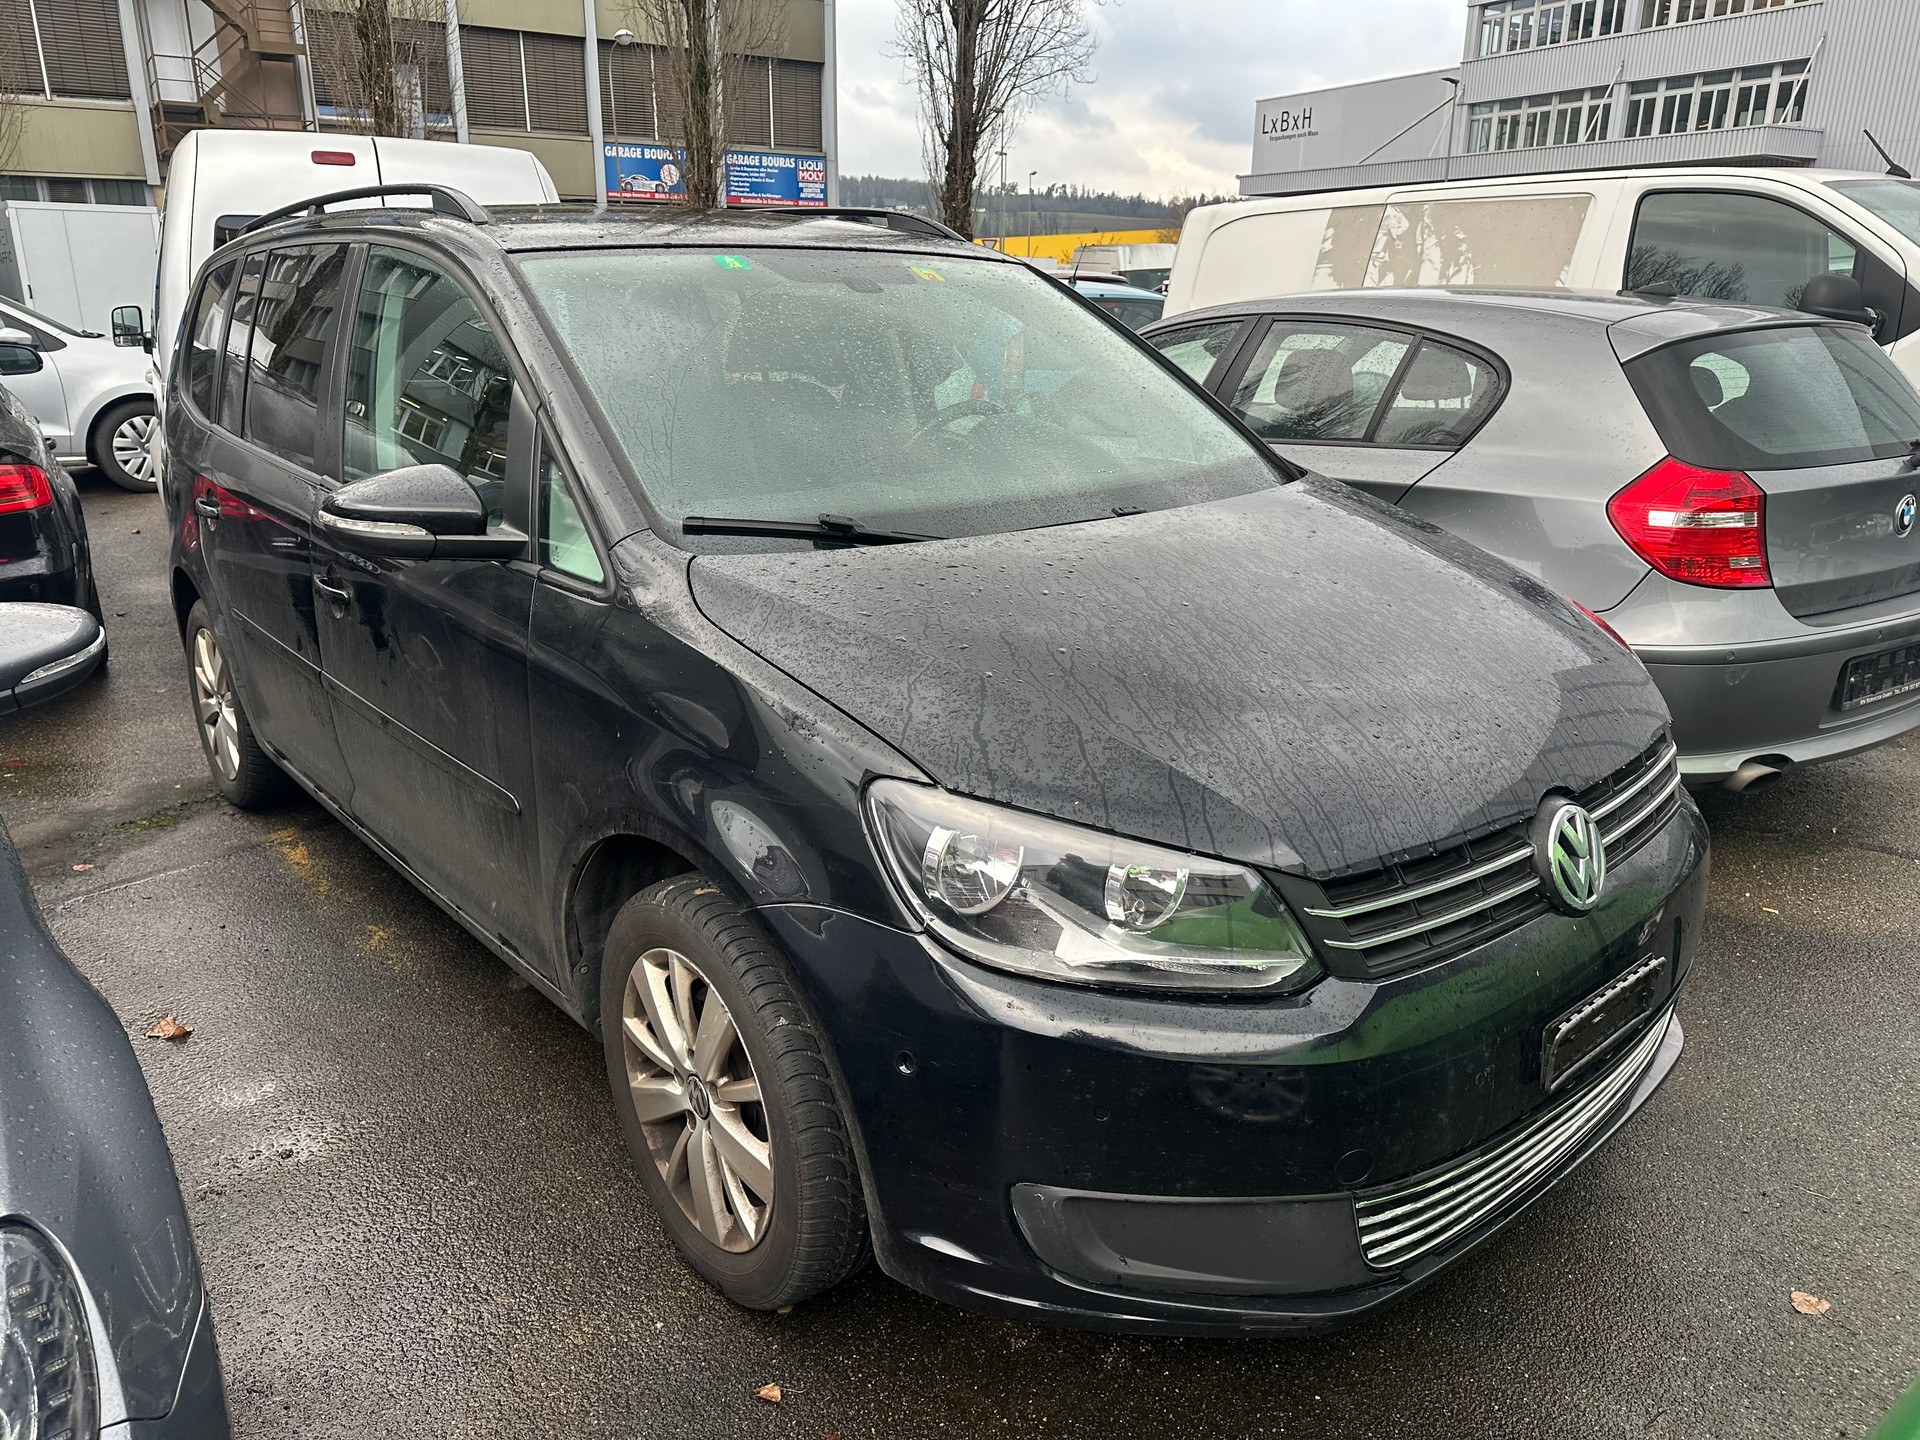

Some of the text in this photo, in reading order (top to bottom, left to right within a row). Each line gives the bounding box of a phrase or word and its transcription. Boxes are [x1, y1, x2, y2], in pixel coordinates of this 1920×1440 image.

[1262, 107, 1312, 134] LxBxH
[604, 146, 642, 158] GARAGE
[726, 154, 795, 168] GARAGE BOURAS
[799, 160, 823, 171] LIQUI
[799, 171, 825, 181] MOLY
